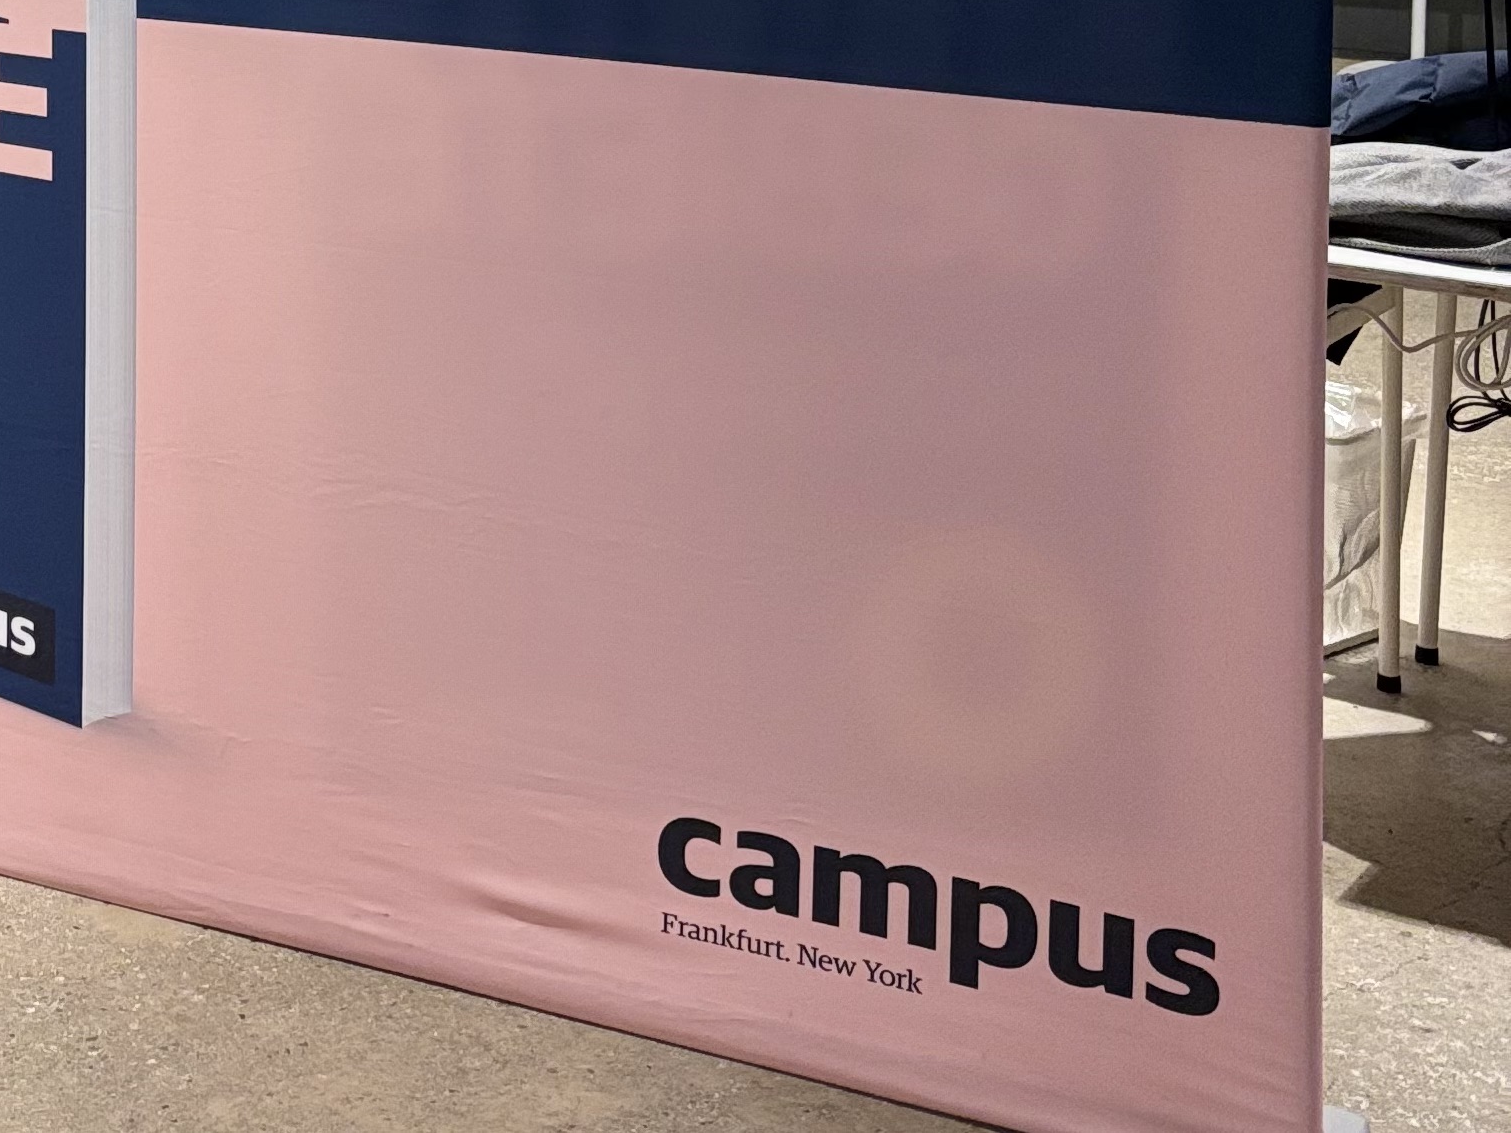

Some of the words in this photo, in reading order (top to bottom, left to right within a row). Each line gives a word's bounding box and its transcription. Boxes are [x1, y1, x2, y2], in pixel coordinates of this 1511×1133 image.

[658, 817, 1220, 1016] campus
[661, 912, 790, 962] Frankfurt.
[796, 943, 856, 977] New
[862, 959, 923, 995] York
